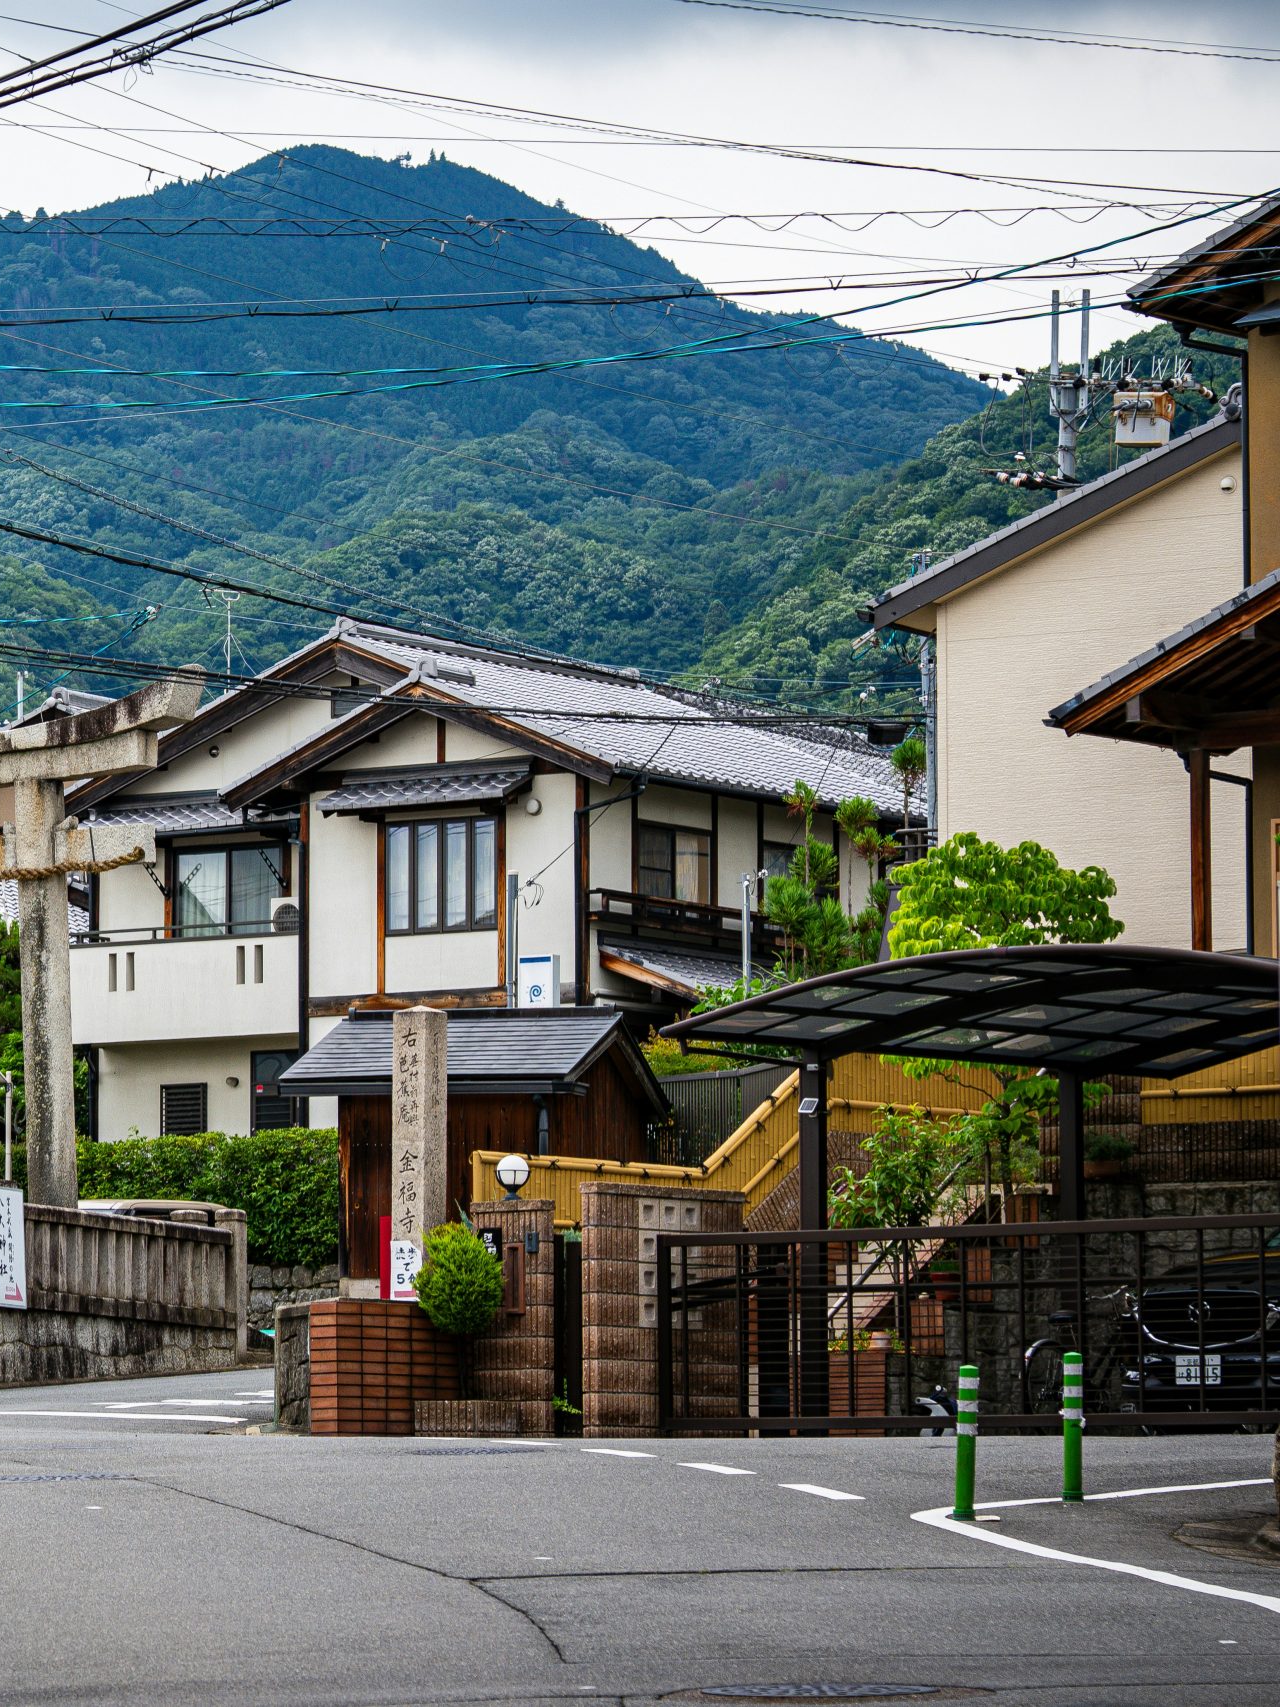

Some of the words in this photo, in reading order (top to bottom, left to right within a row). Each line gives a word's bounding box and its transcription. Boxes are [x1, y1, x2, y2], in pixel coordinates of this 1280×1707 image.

[402, 1027, 418, 1047] 右
[398, 1149, 418, 1234] 金福寺
[403, 1261, 414, 1271] で
[1186, 1367, 1219, 1382] 8115
